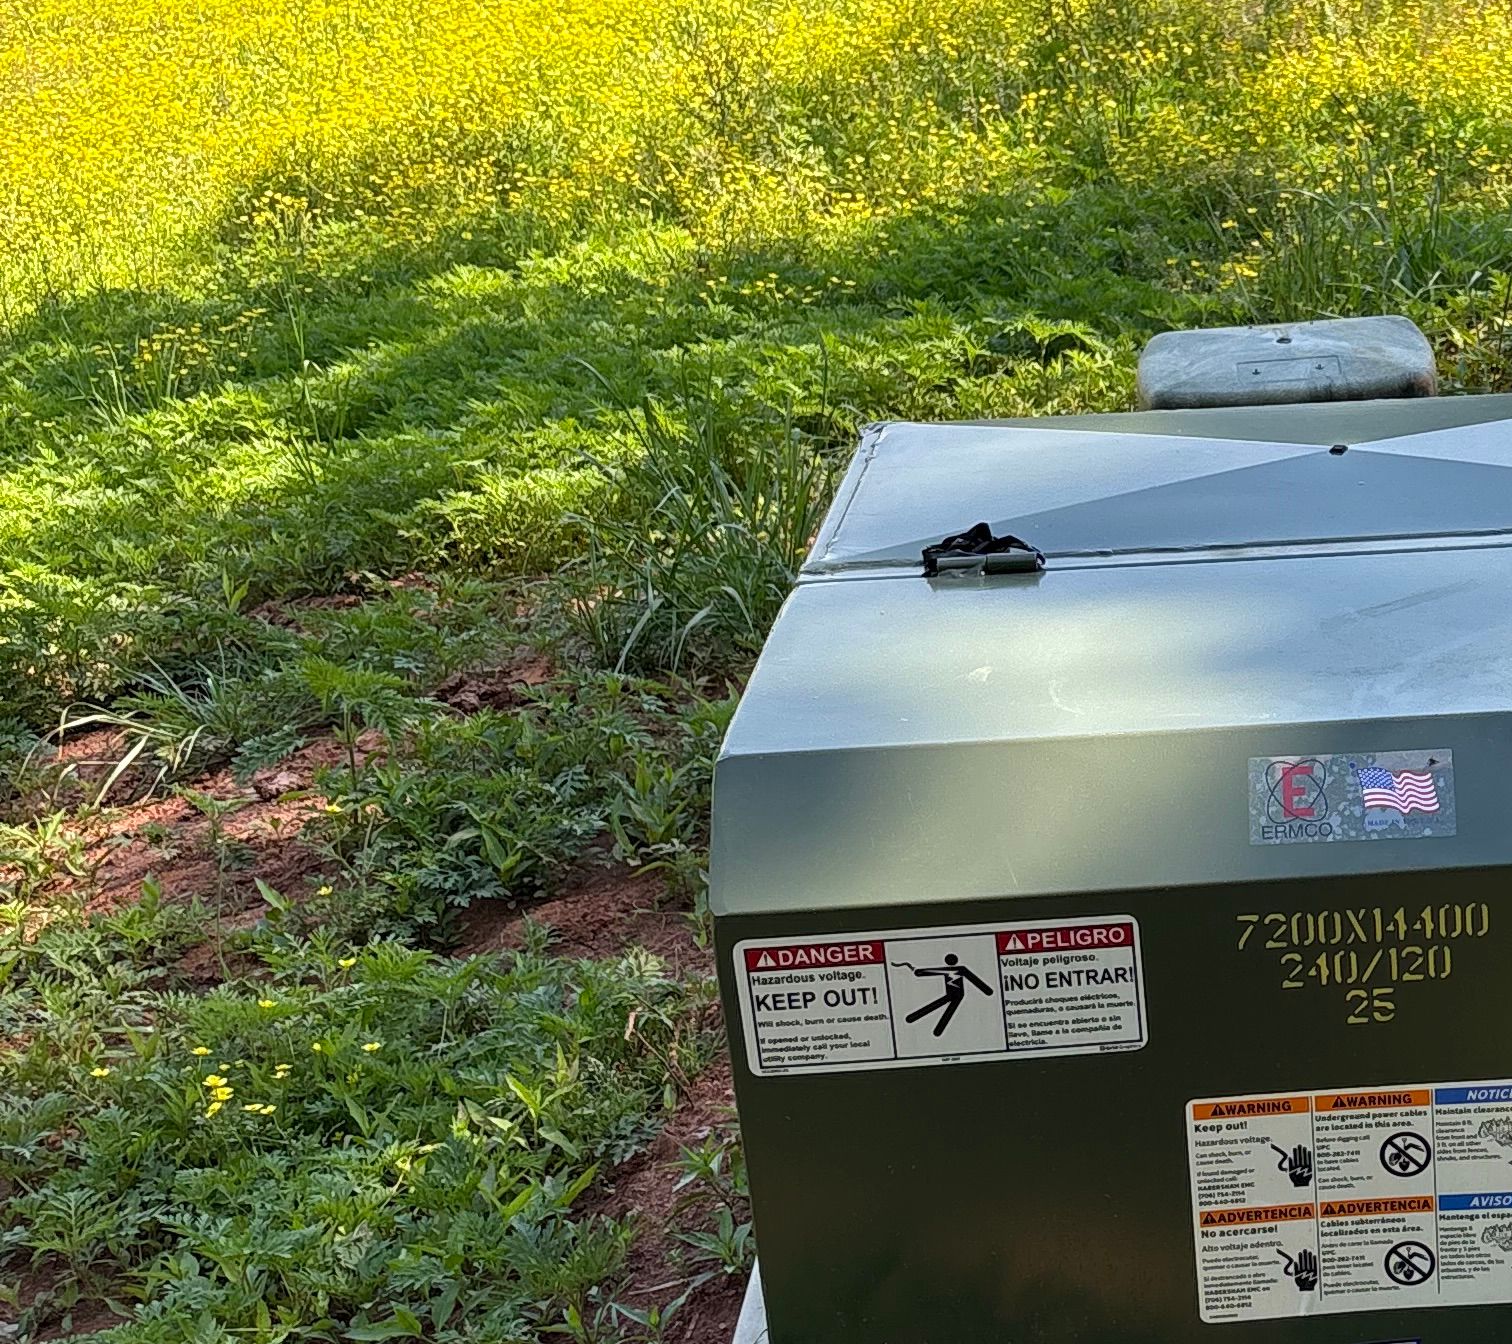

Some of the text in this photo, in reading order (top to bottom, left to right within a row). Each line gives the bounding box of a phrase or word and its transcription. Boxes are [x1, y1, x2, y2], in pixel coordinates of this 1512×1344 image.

[1261, 821, 1333, 841] ERMCO
[1236, 902, 1490, 950] 7200X14400
[1027, 926, 1125, 949] PELIGRO
[777, 944, 874, 965] DANGER
[1001, 951, 1098, 969] Voltaje peligroso.
[1280, 945, 1452, 989] 240/120
[752, 969, 865, 985] Hazardous voltage.
[1003, 966, 1133, 991] ¡NO ENTRAR!
[755, 987, 877, 1011] KEEP OUT!
[1045, 995, 1078, 1004] choques
[1345, 987, 1396, 1024] 25
[775, 1019, 802, 1027] shock,
[864, 1013, 888, 1021] death.
[1029, 1019, 1069, 1027] encuentra
[1071, 1016, 1099, 1024] abierto
[768, 1036, 798, 1045] opened
[811, 1032, 851, 1041] unlocked,
[1347, 1093, 1411, 1107] WARNING
[1225, 1101, 1291, 1115] WARNING
[1435, 1107, 1471, 1115] Maintain
[1315, 1112, 1370, 1123] Underground
[1372, 1110, 1398, 1119] power
[1194, 1121, 1247, 1134] Keep out!
[1331, 1122, 1362, 1130] located
[1194, 1134, 1272, 1146] Hazardous voltage.
[1197, 1183, 1239, 1191] HABERSHAM
[1337, 1198, 1430, 1214] ADVERTENCIA
[1470, 1195, 1512, 1207] AVISO
[1217, 1206, 1311, 1222] ADVERTENCIA
[1320, 1215, 1405, 1227] Cables subterráneos
[1439, 1212, 1479, 1222] Mantenga
[1200, 1224, 1277, 1238] No acercarse!
[1320, 1228, 1368, 1237] localizados
[1220, 1242, 1248, 1252] voltaje
